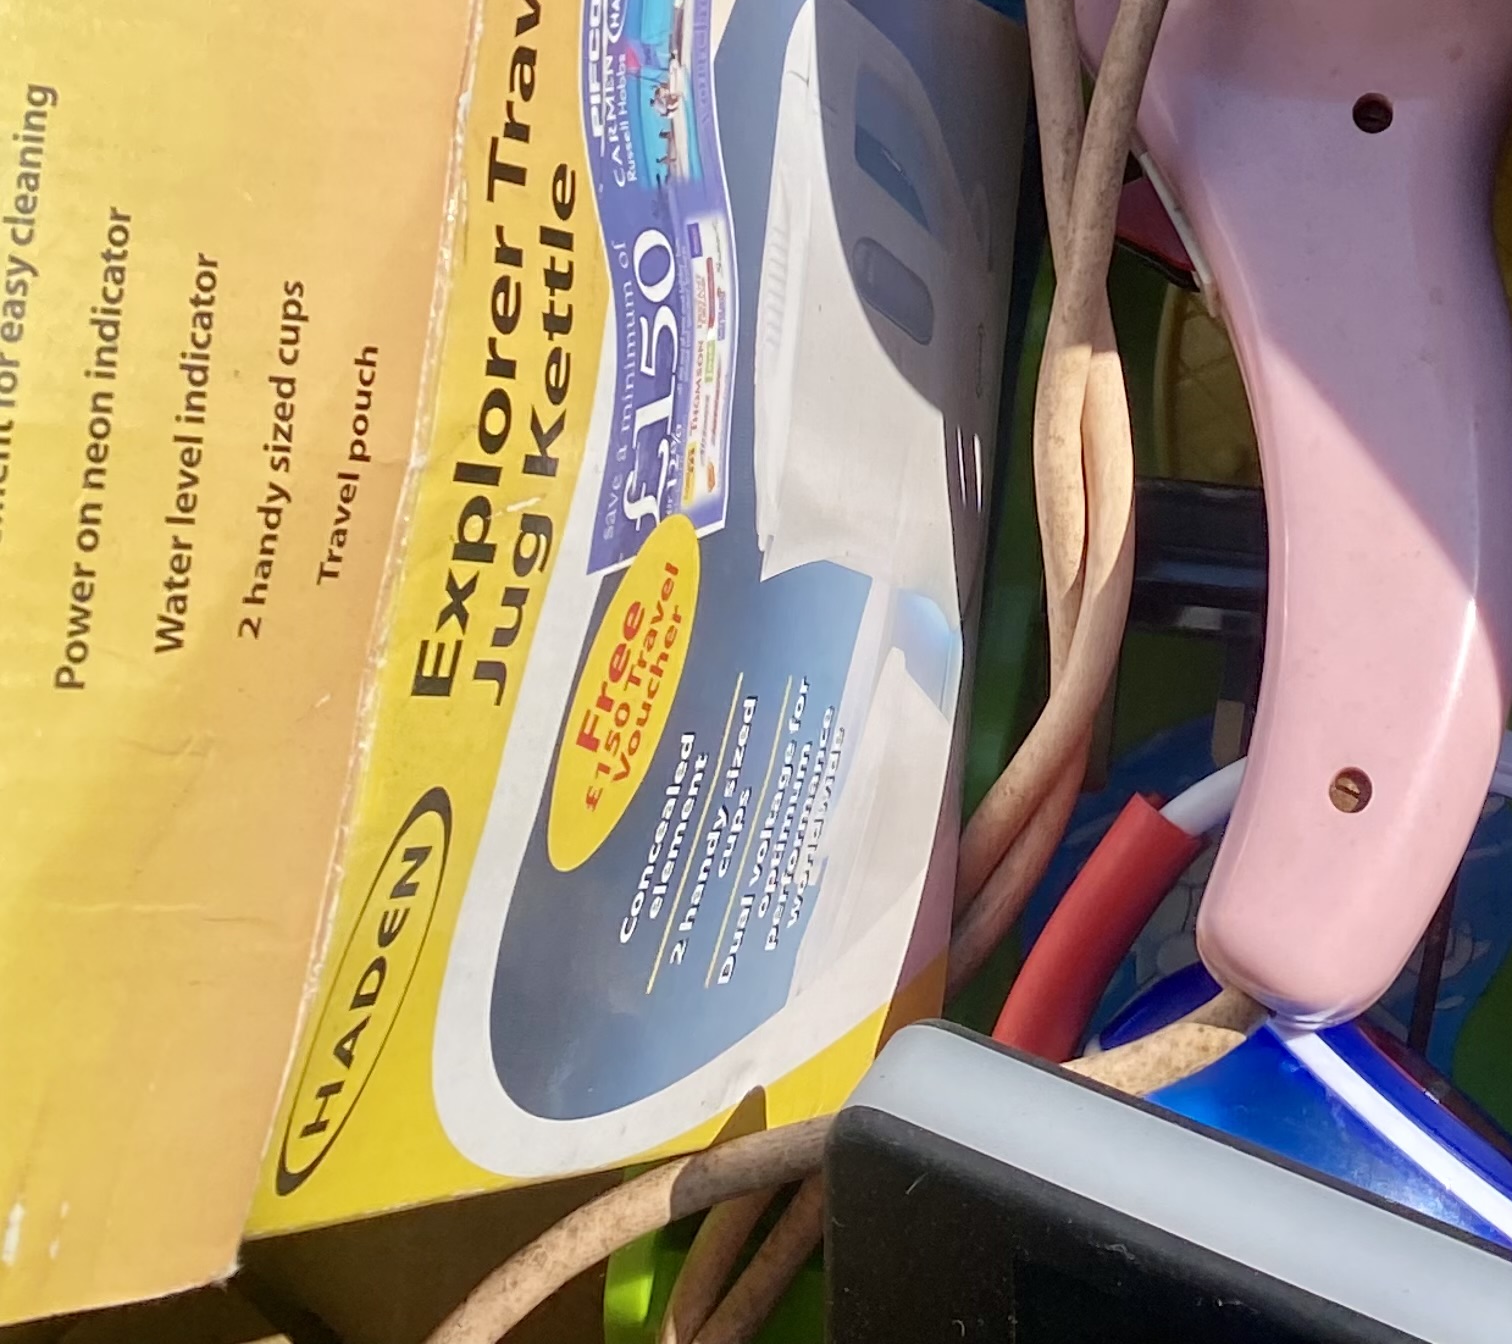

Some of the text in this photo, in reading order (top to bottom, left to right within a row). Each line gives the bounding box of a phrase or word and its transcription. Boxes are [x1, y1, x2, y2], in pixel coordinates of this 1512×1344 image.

[3, 83, 58, 247] cleaning
[605, 54, 626, 188] CARMEN
[616, 53, 638, 183] Russell Hobbs
[0, 254, 39, 344] easy
[603, 239, 637, 540] save a minimum of
[622, 228, 679, 532] £150
[55, 206, 132, 690] Power on neon indicator
[154, 252, 219, 654] Water level indicator
[237, 280, 310, 640] 2 handy sized cups
[316, 345, 379, 586] Travel pouch
[411, 225, 523, 699] Explorer
[473, 162, 576, 707] Jug Kettle
[575, 600, 646, 754] Free
[585, 561, 679, 812] £150 Travel
[611, 603, 683, 783] Voucher
[619, 731, 697, 944] Concealed
[649, 751, 710, 920] element
[669, 694, 759, 965] 2 handy sized
[717, 674, 811, 986] Dual voltage for
[718, 785, 753, 879] cups
[758, 740, 814, 919] optimum
[764, 704, 836, 951] performance
[786, 726, 846, 929] worldwide
[299, 844, 433, 1140] HADEN
